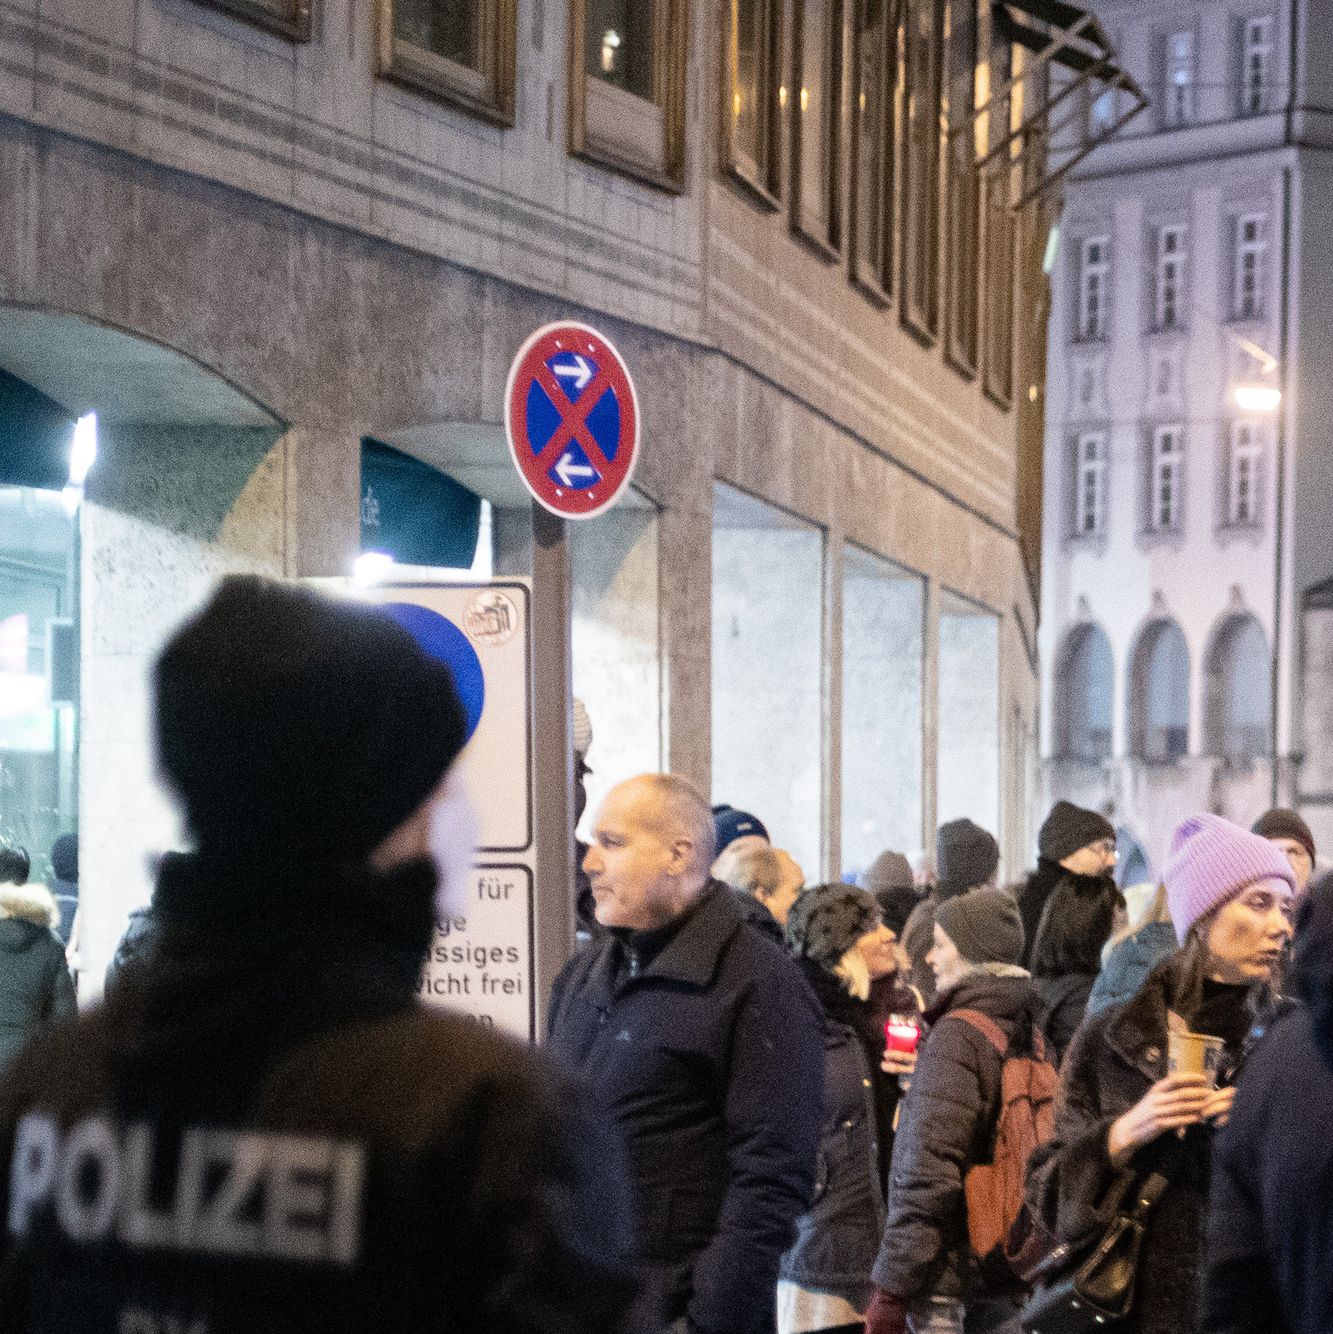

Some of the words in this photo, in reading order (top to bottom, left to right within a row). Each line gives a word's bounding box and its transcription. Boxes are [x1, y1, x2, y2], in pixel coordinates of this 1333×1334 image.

[477, 877, 514, 899] für
[482, 972, 522, 995] frei
[8, 1110, 365, 1267] POLIZEI
